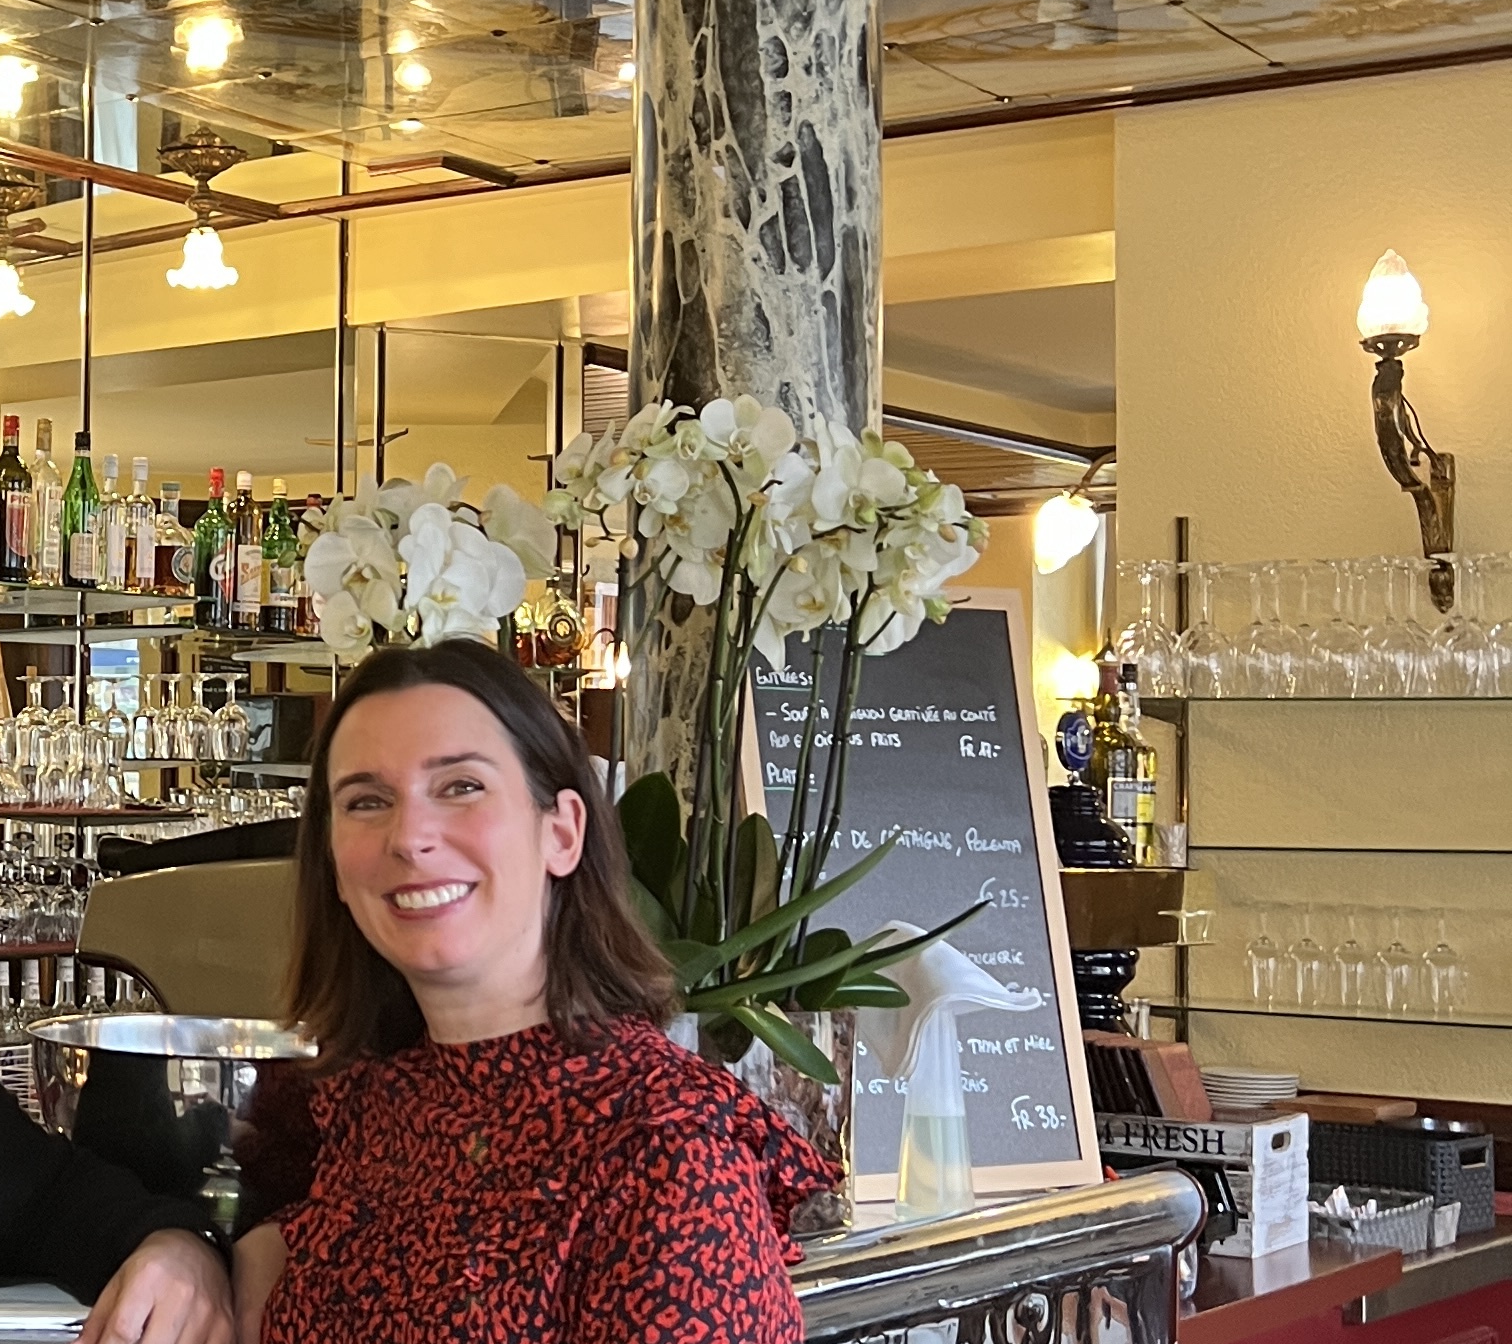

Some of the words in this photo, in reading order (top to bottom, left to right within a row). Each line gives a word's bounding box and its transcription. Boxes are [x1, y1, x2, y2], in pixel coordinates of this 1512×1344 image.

[766, 762, 816, 786] PLAT:
[1004, 1037, 1021, 1054] ET
[959, 1070, 989, 1094] RAIS
[1122, 1120, 1227, 1156] FRESH
